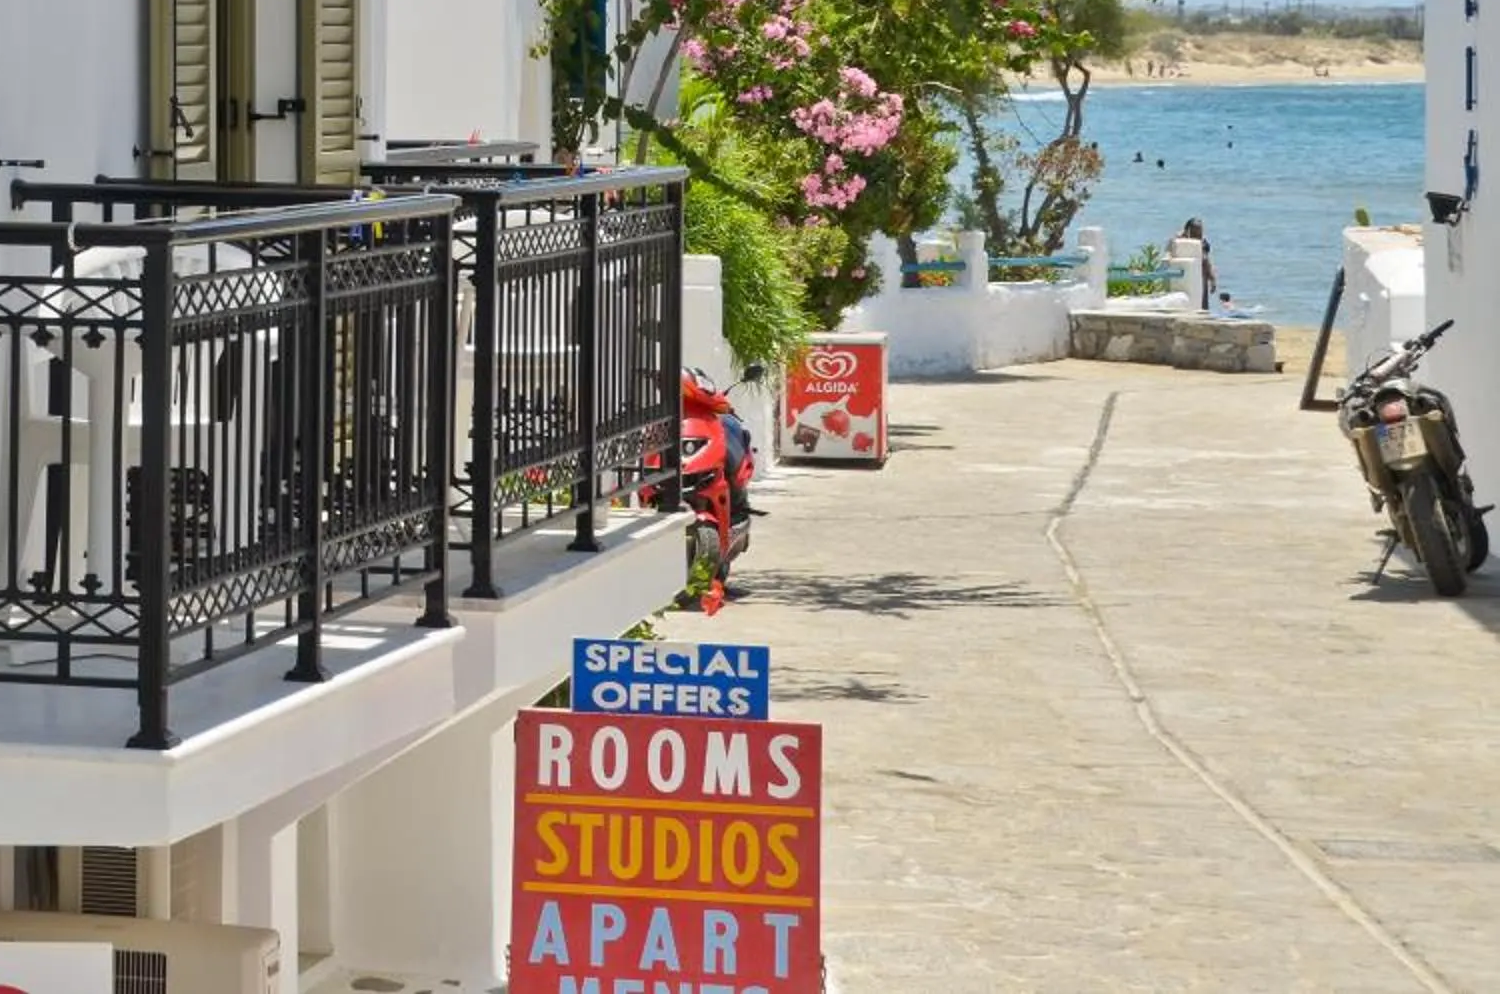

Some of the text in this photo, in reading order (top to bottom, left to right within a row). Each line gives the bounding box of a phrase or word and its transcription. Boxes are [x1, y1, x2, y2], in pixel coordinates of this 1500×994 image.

[804, 381, 857, 394] ALGIDA
[584, 643, 759, 679] SPECIAL
[591, 681, 751, 716] OFFERS
[537, 723, 801, 799] ROOMS
[535, 811, 799, 889] STUDIOS
[528, 901, 800, 979] APART
